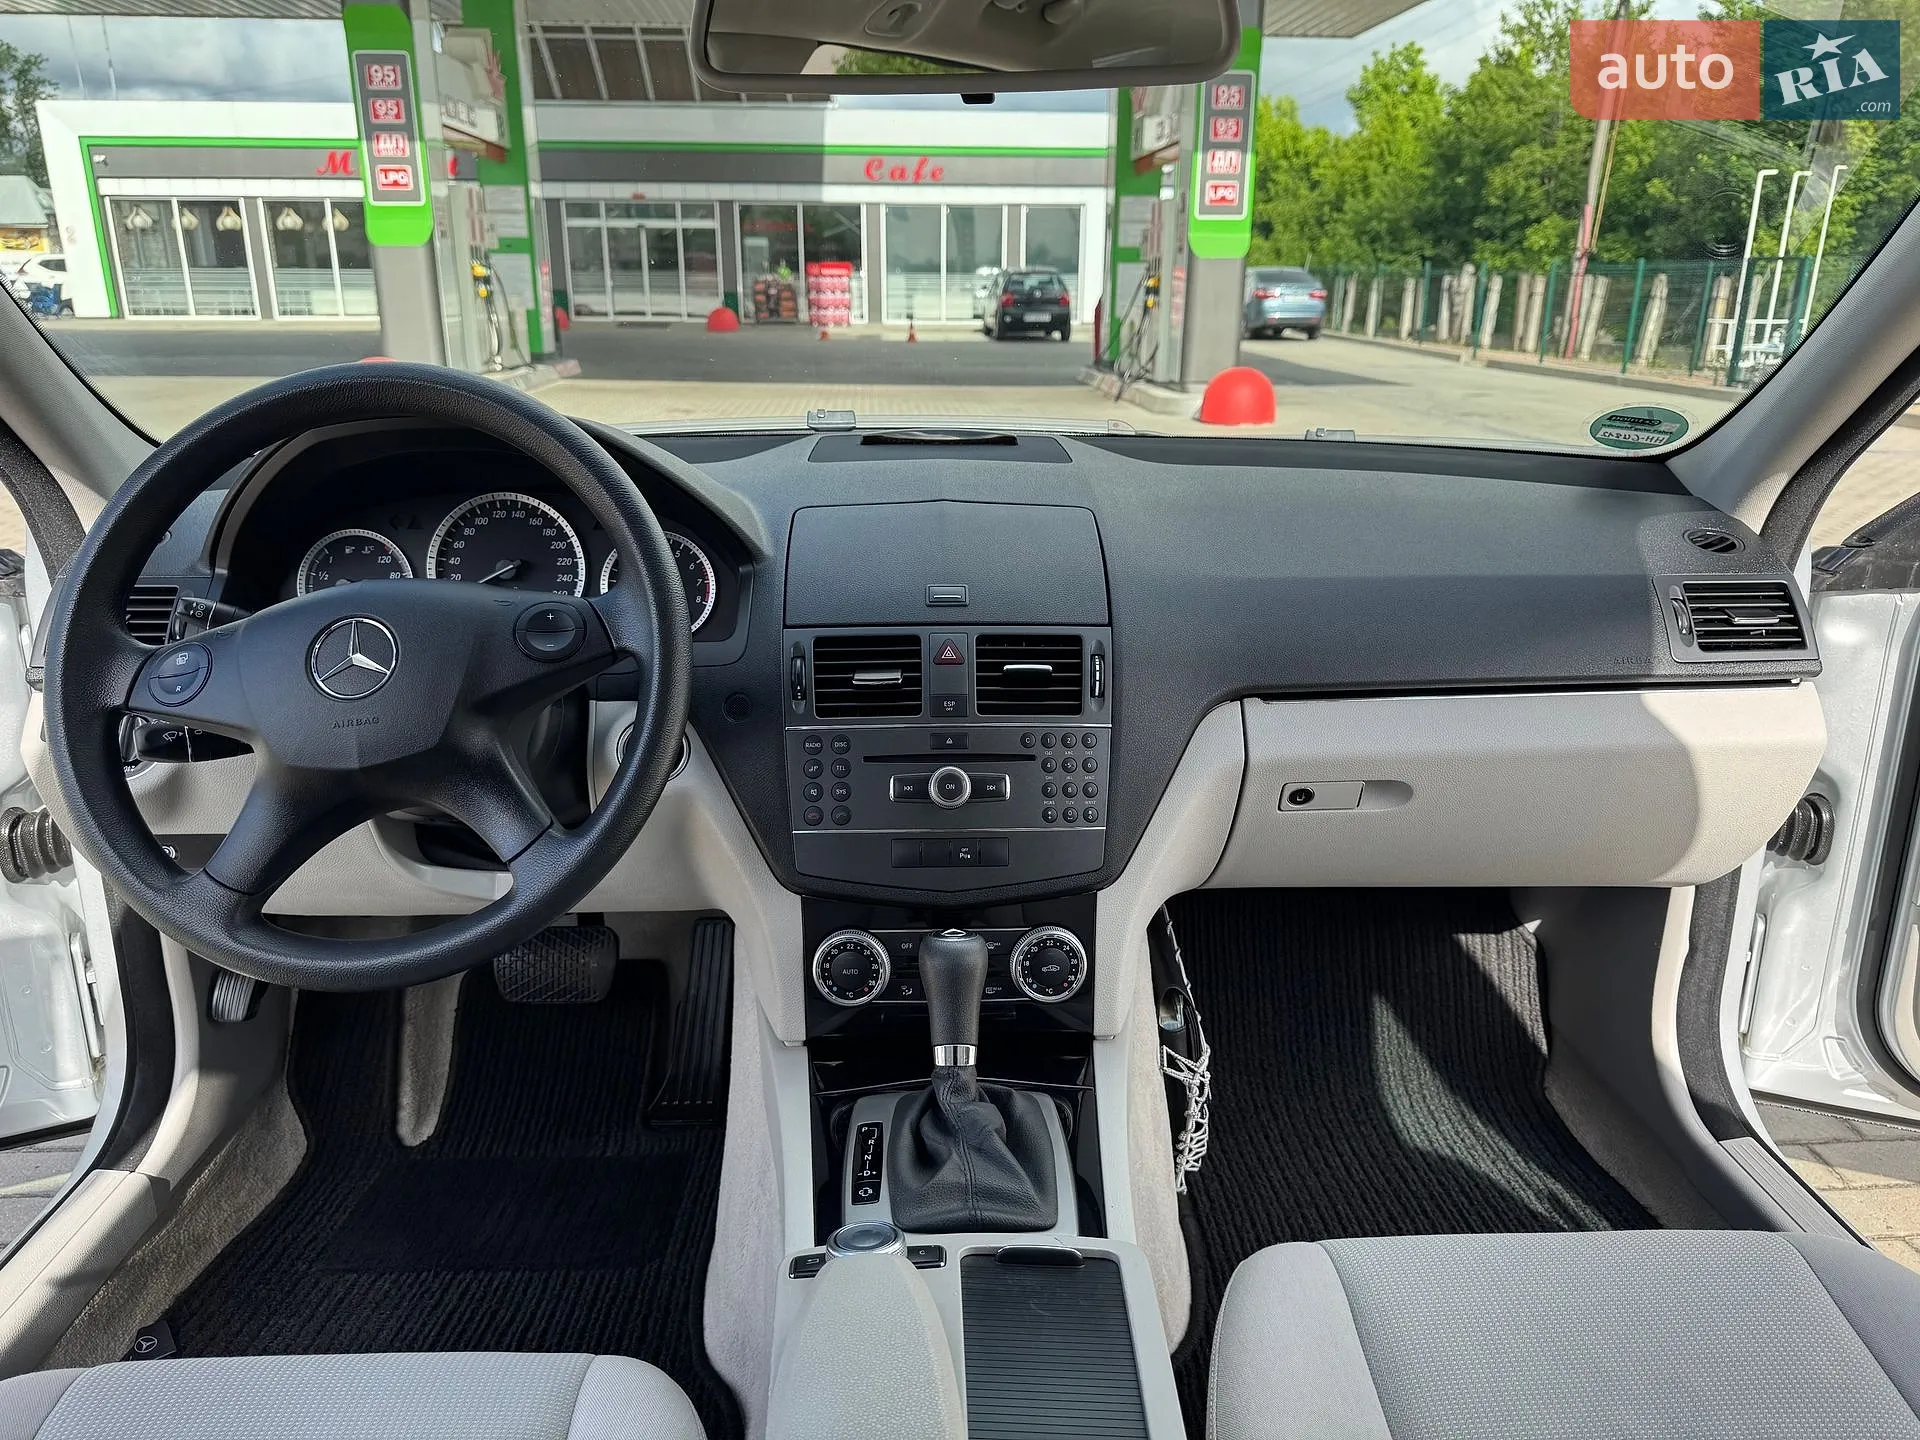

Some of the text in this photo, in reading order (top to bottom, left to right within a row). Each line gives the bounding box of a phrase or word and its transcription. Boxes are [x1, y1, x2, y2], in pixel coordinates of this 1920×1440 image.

[370, 65, 397, 83] 95
[864, 156, 945, 185] Cafe
[381, 171, 409, 185] LPG
[492, 510, 506, 518] 120
[511, 510, 526, 518] 140
[475, 517, 489, 525] 100
[529, 517, 543, 525] 160
[464, 527, 475, 536] 80
[542, 527, 557, 536] 180
[453, 541, 465, 549] 60
[551, 541, 567, 550] 200
[675, 550, 681, 558] 5
[377, 556, 392, 564] 120
[449, 557, 461, 565] 40
[557, 557, 573, 565] 220
[689, 561, 695, 570] 6
[557, 573, 573, 582] 240
[696, 578, 702, 586] 7
[695, 595, 701, 603] 8
[332, 716, 380, 730] AIRBAG
[945, 782, 956, 790] ON
